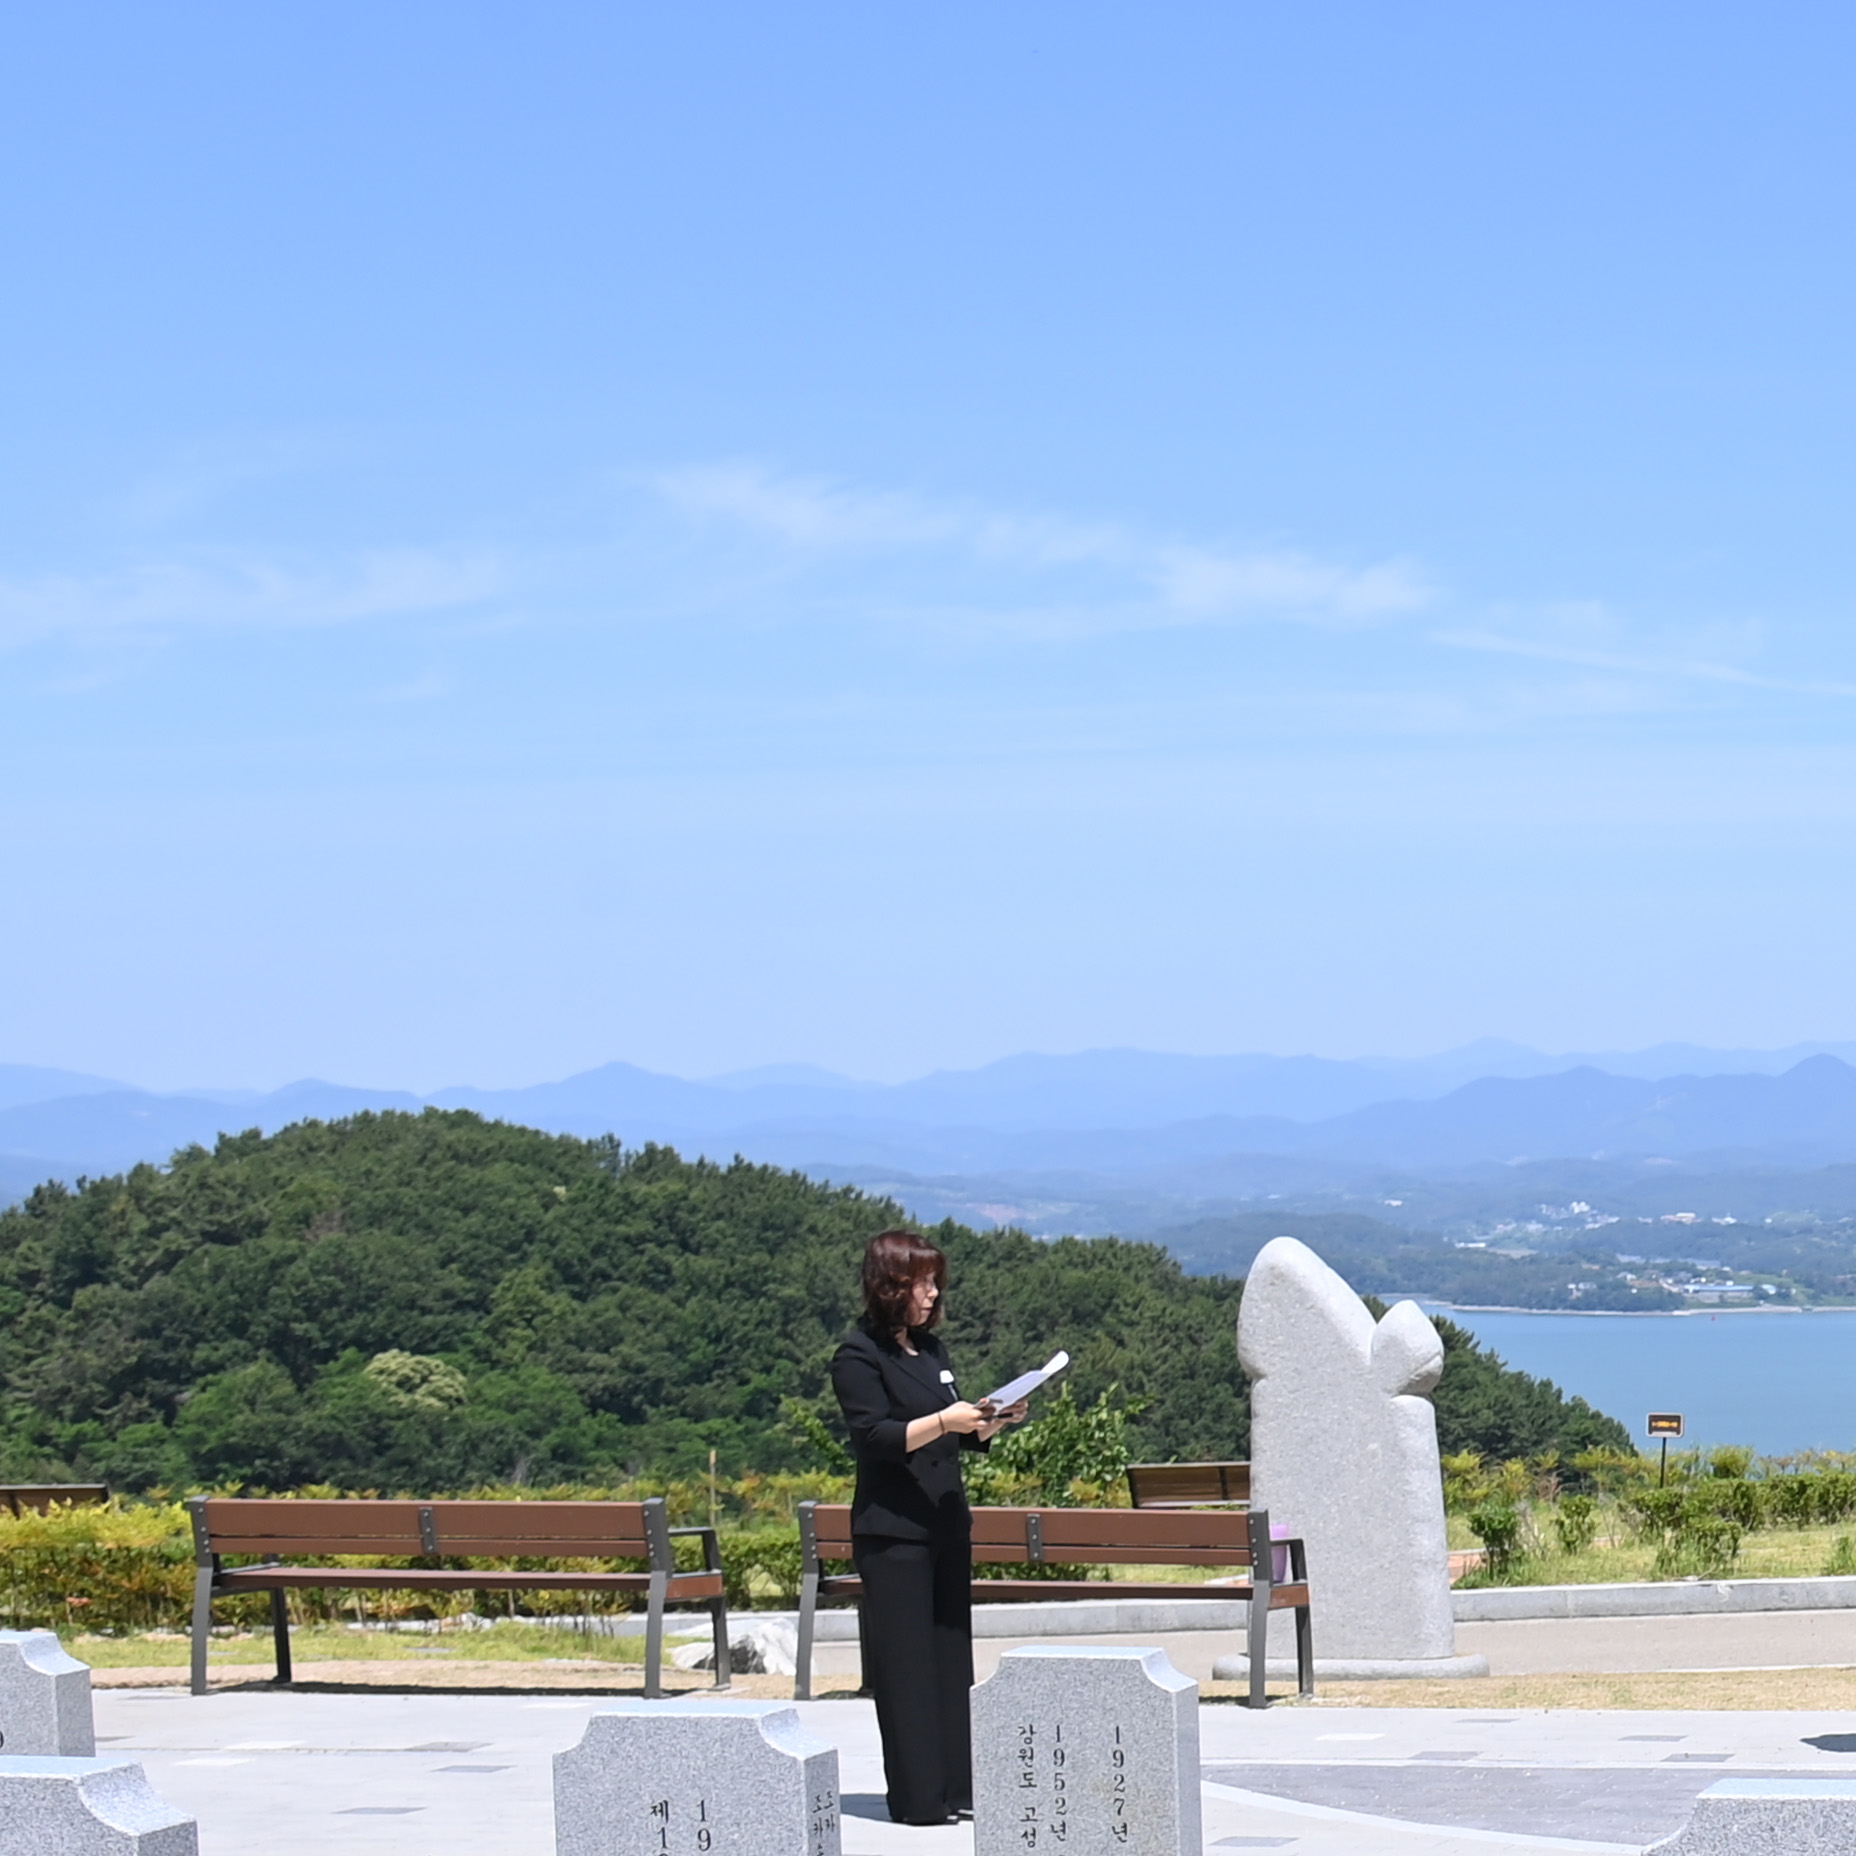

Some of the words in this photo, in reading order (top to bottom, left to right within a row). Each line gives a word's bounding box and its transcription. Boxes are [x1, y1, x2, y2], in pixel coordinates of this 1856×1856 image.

[1019, 1724, 1036, 1788] 강원도
[1051, 1725, 1066, 1841] 1952년
[1112, 1726, 1127, 1843] 1927년
[823, 1791, 834, 1831] 조카
[1021, 1807, 1037, 1847] 고성
